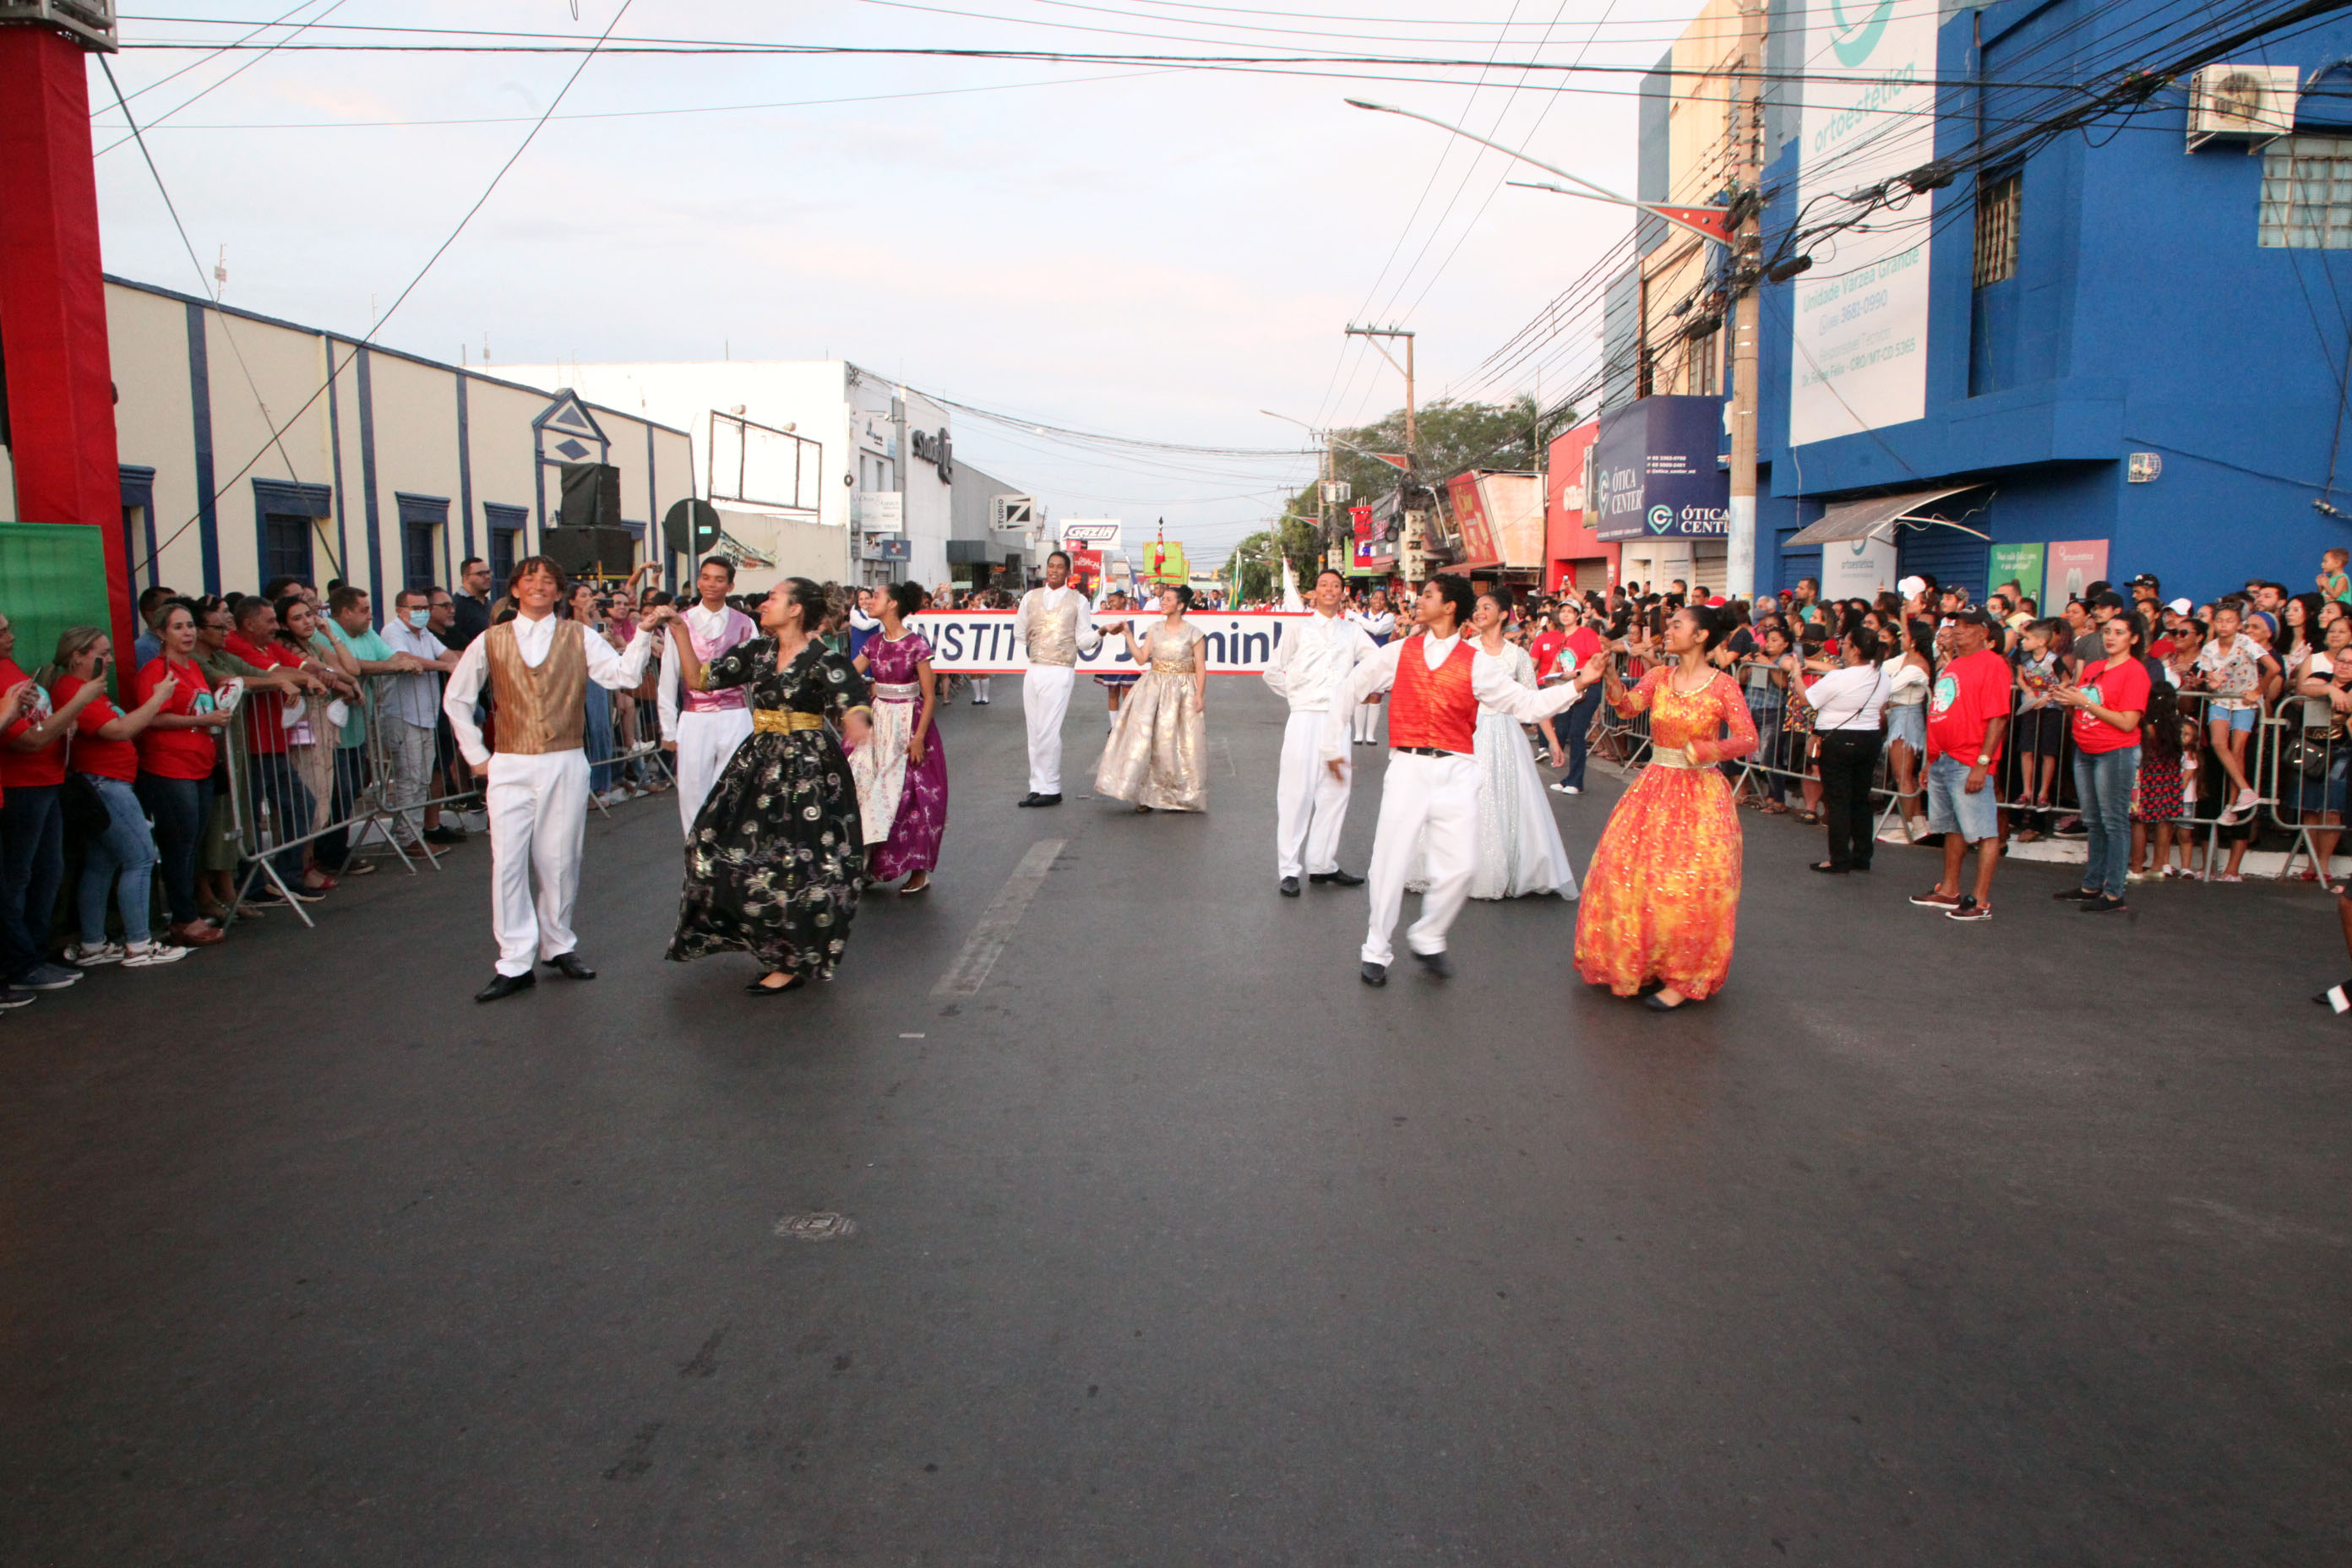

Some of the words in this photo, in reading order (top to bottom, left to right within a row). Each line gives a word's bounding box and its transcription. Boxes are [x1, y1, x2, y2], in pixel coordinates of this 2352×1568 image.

[1612, 466, 1636, 493] ÓTICA
[1612, 489, 1642, 515] CENTER
[1680, 504, 1729, 521] ÓTICA
[1067, 526, 1116, 538] GAZIN
